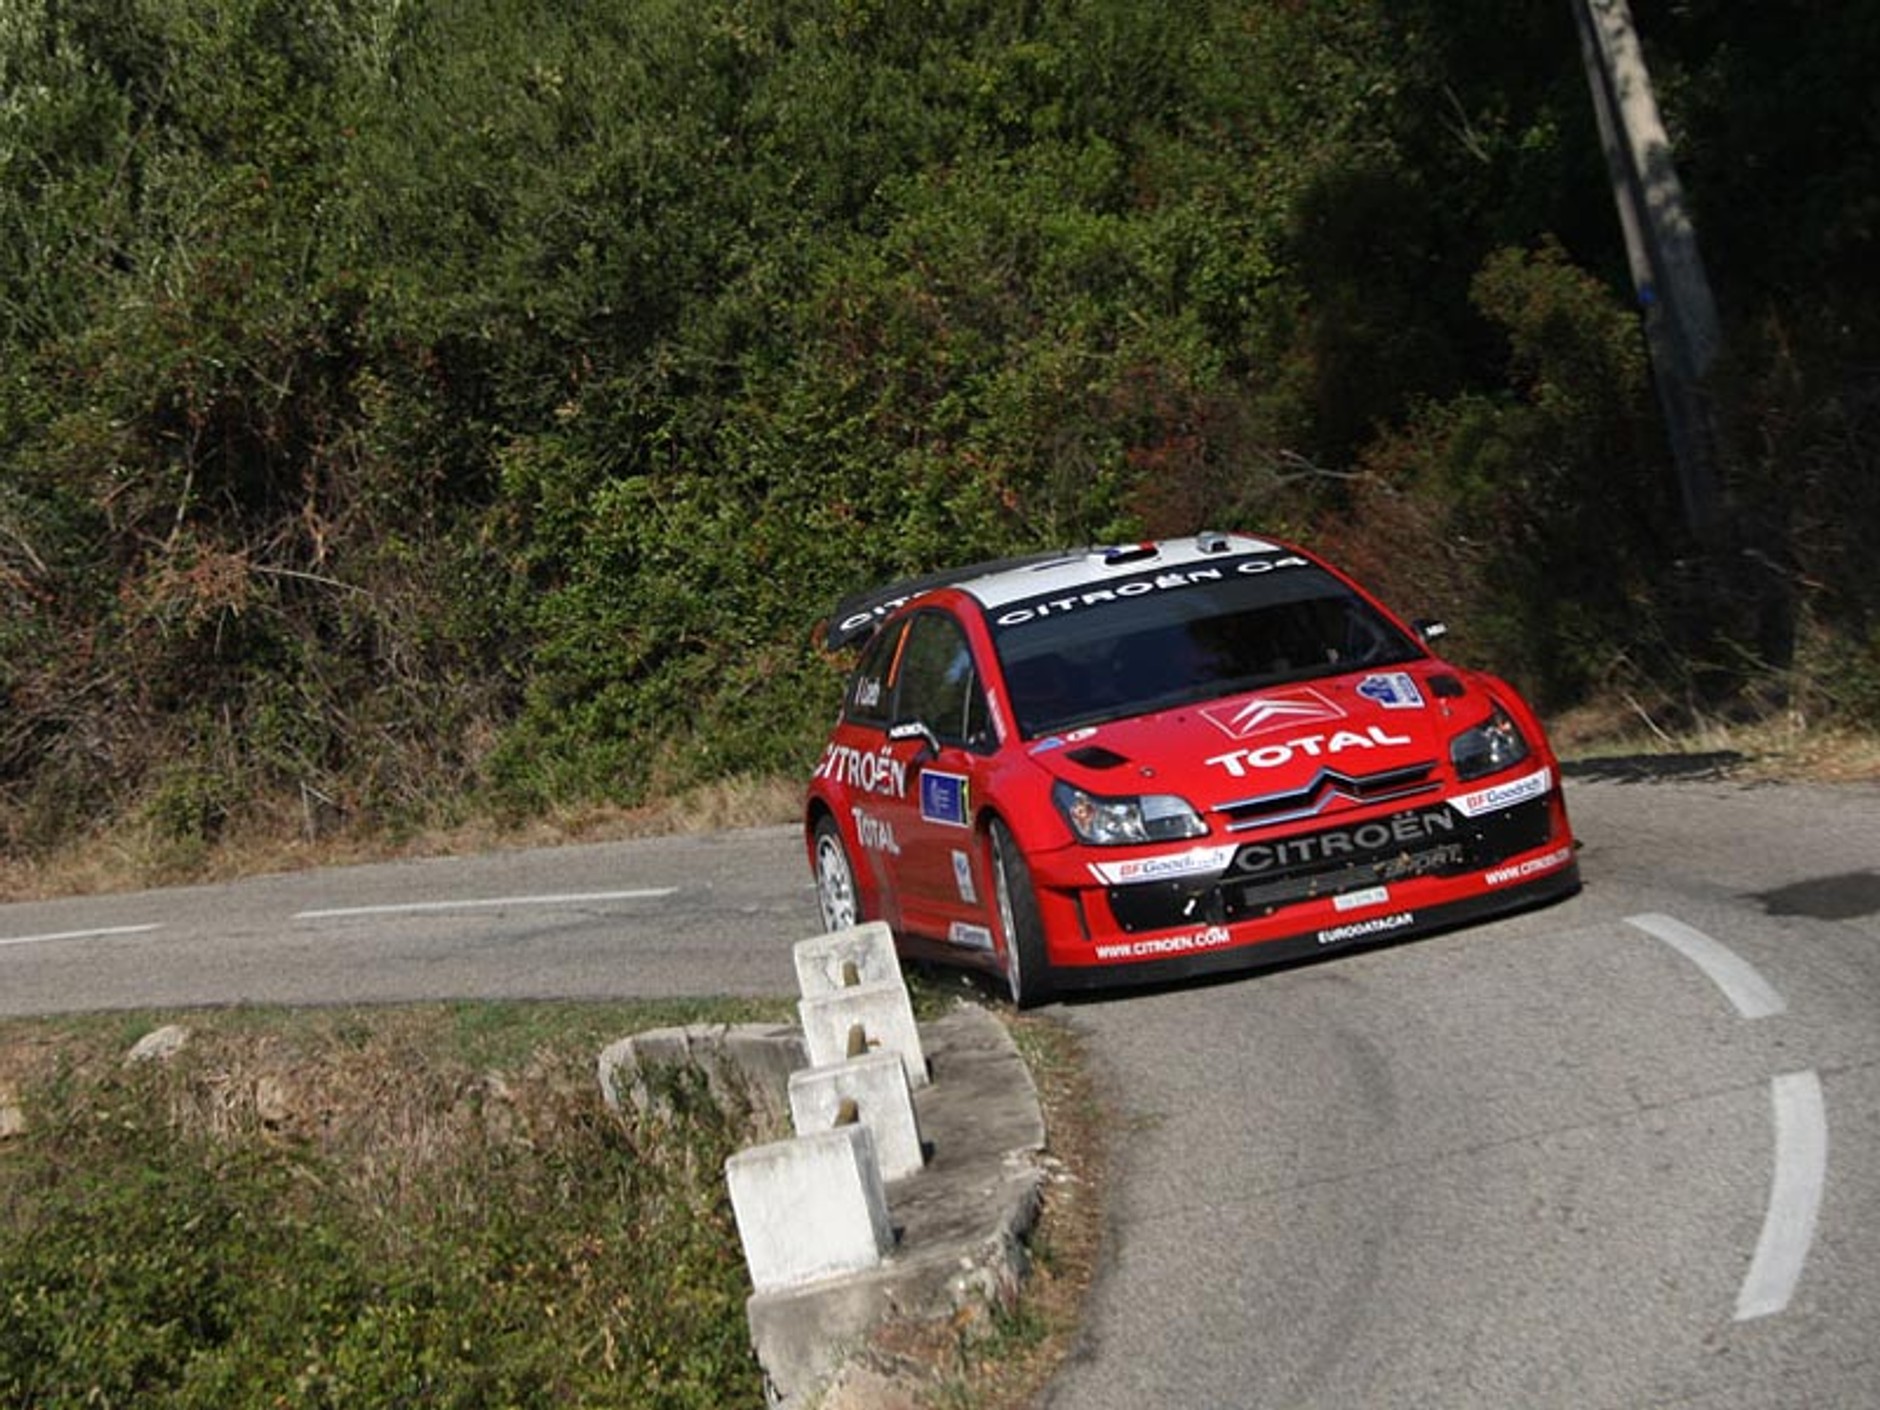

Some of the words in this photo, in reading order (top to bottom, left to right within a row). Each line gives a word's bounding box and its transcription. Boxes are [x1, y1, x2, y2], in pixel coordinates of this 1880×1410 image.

[997, 567, 1223, 625] CITROËN
[1204, 726, 1411, 777] TOTAL
[852, 806, 901, 856] TOTAL
[1235, 807, 1454, 872] CITROËN
[1095, 926, 1230, 959] WWW.CITROEN.COM
[1317, 912, 1414, 945] EURODATACAR
